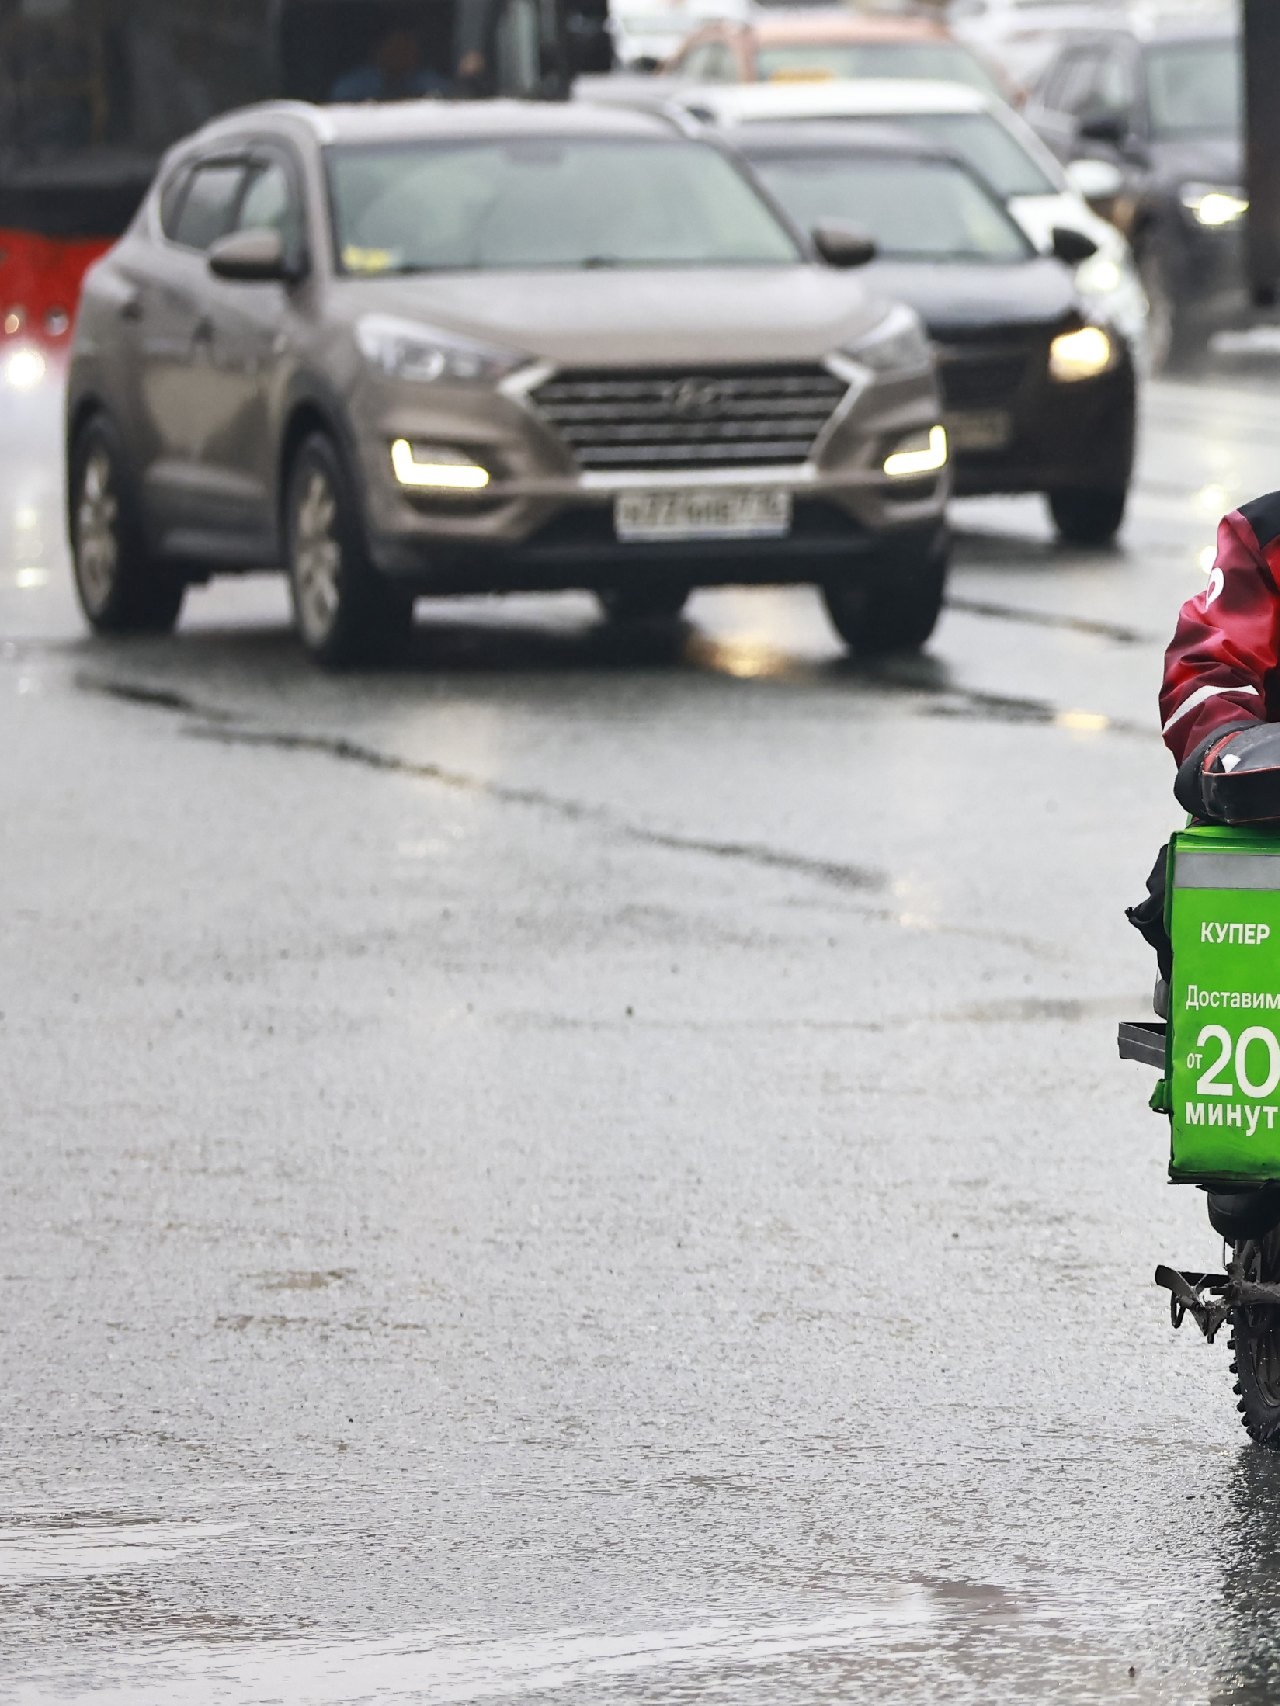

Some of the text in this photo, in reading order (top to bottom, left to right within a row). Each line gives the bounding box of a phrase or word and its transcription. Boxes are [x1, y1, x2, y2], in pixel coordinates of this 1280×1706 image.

[1201, 922, 1270, 945] КУПЕР
[1186, 1053, 1203, 1070] от
[1185, 1101, 1279, 1137] минут
